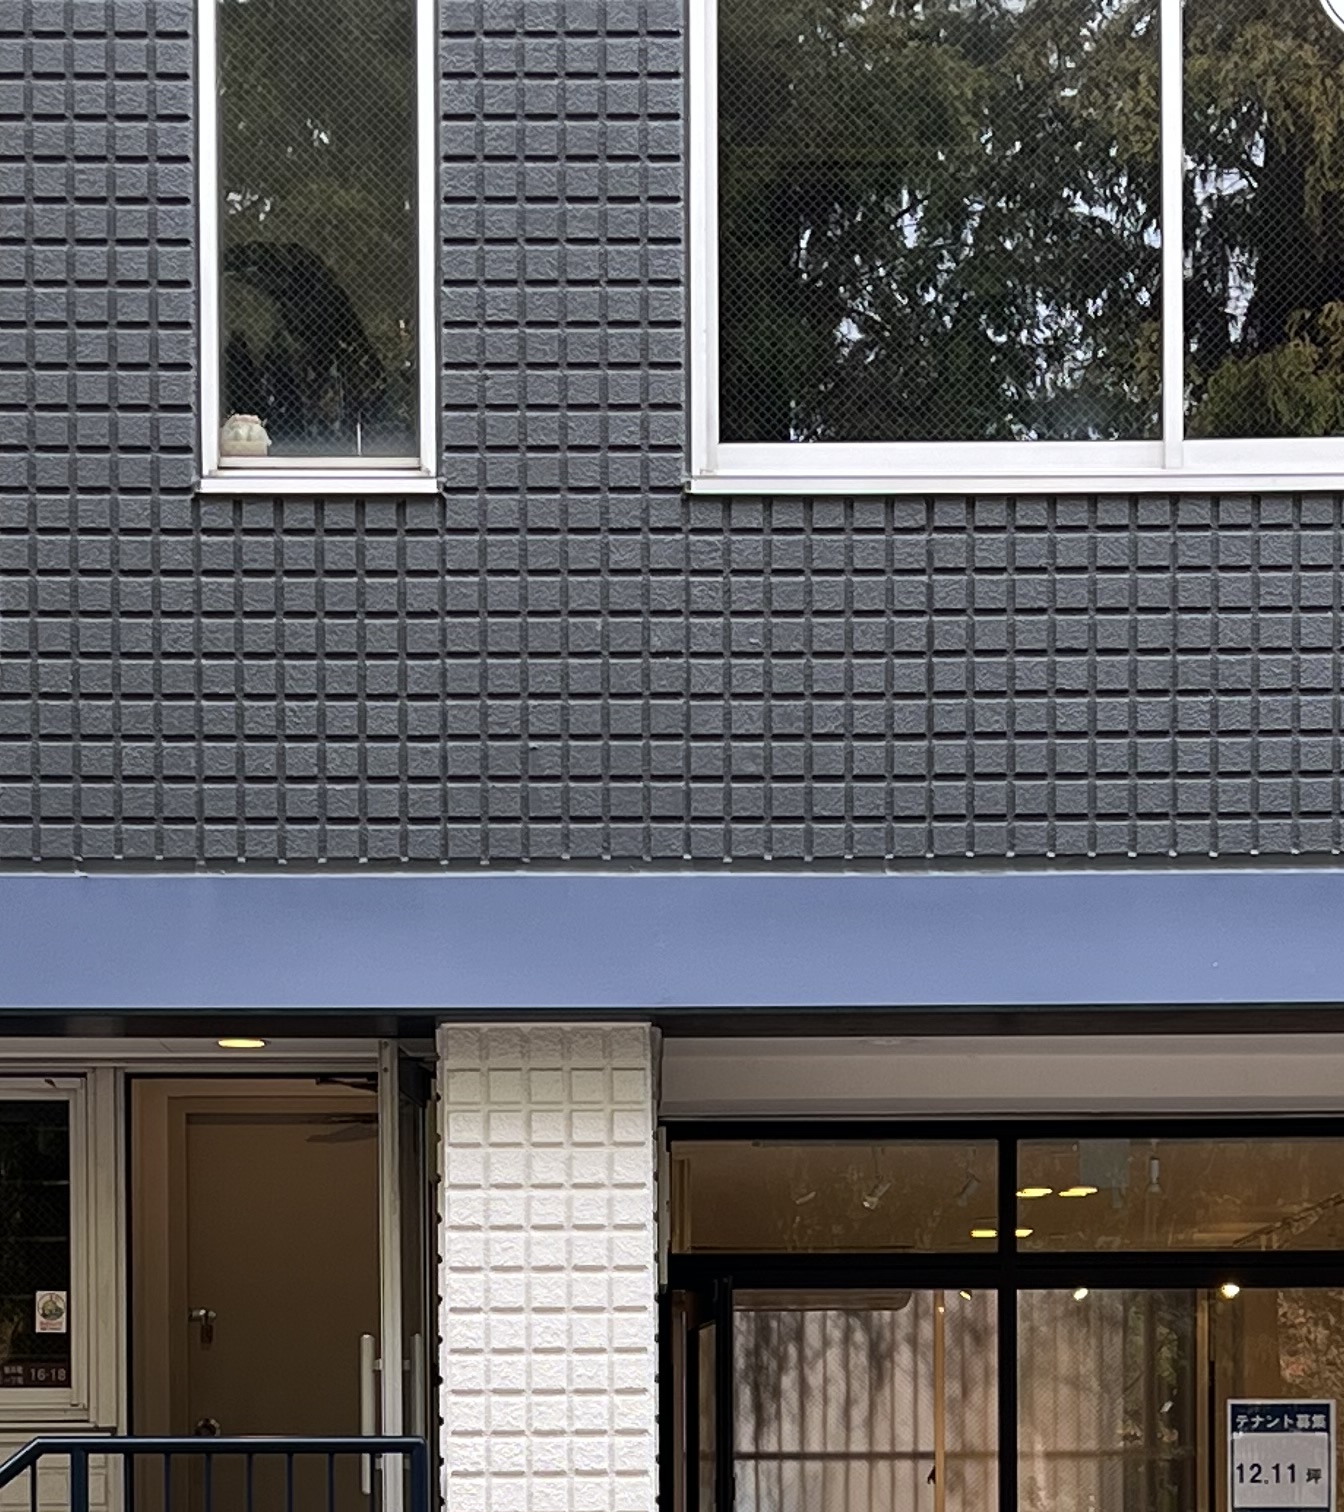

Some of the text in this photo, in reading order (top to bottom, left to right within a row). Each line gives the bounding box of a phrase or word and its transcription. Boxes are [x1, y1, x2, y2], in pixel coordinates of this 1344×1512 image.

[1235, 1413, 1327, 1429] テナント募集
[1236, 1462, 1322, 1485] 12.11 坪
